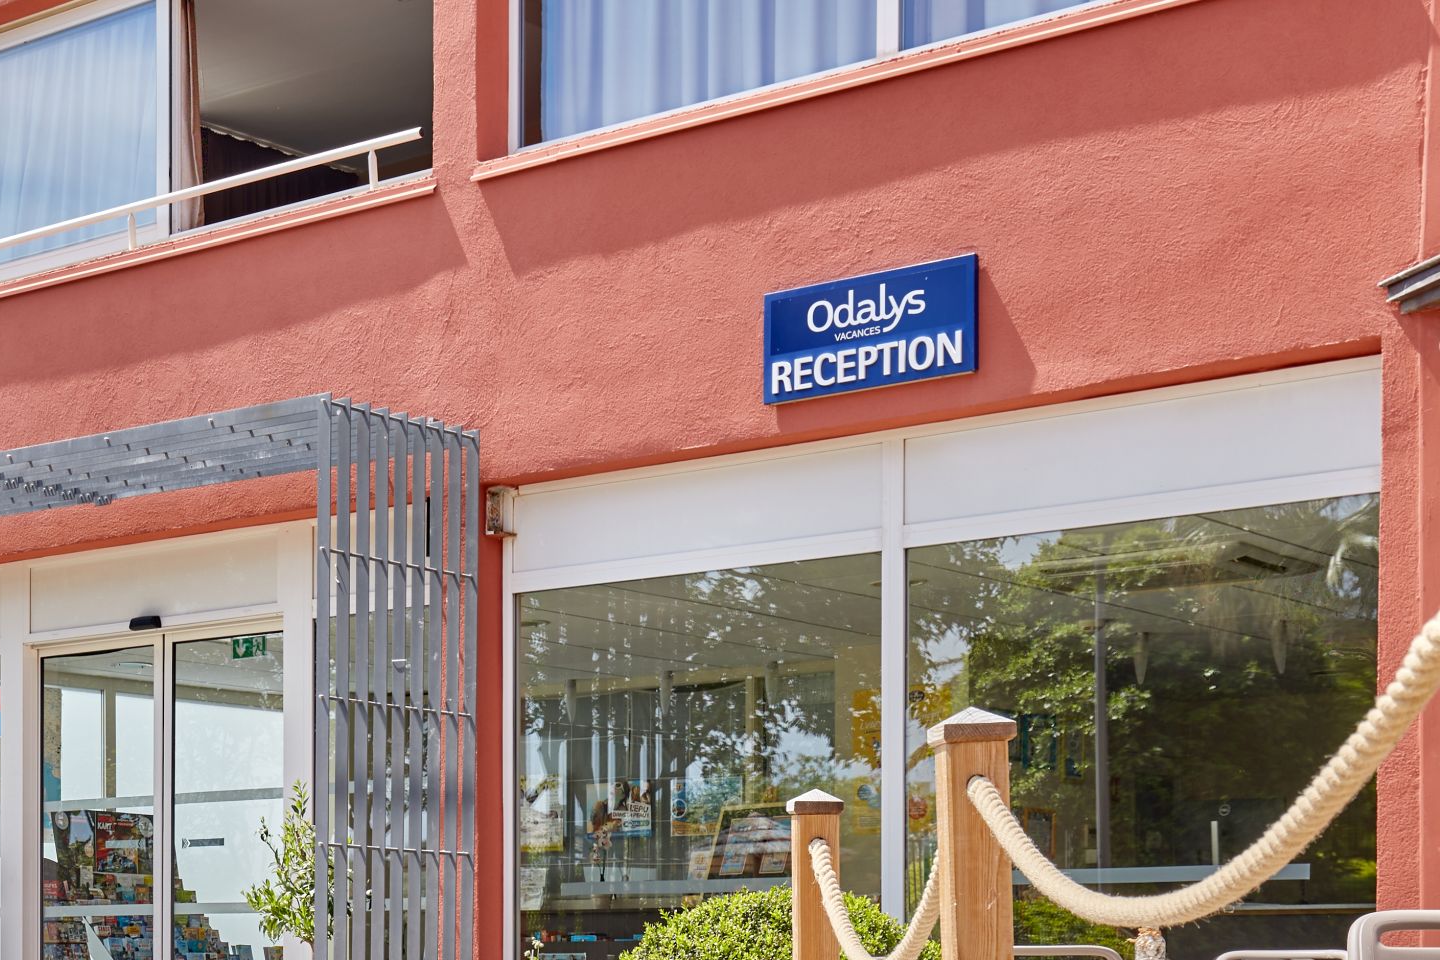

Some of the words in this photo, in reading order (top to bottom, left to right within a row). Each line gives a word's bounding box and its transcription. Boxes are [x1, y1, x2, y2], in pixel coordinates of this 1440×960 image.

[806, 283, 926, 333] Odalys
[834, 325, 881, 342] VACANCES
[771, 329, 963, 395] RECEPTION
